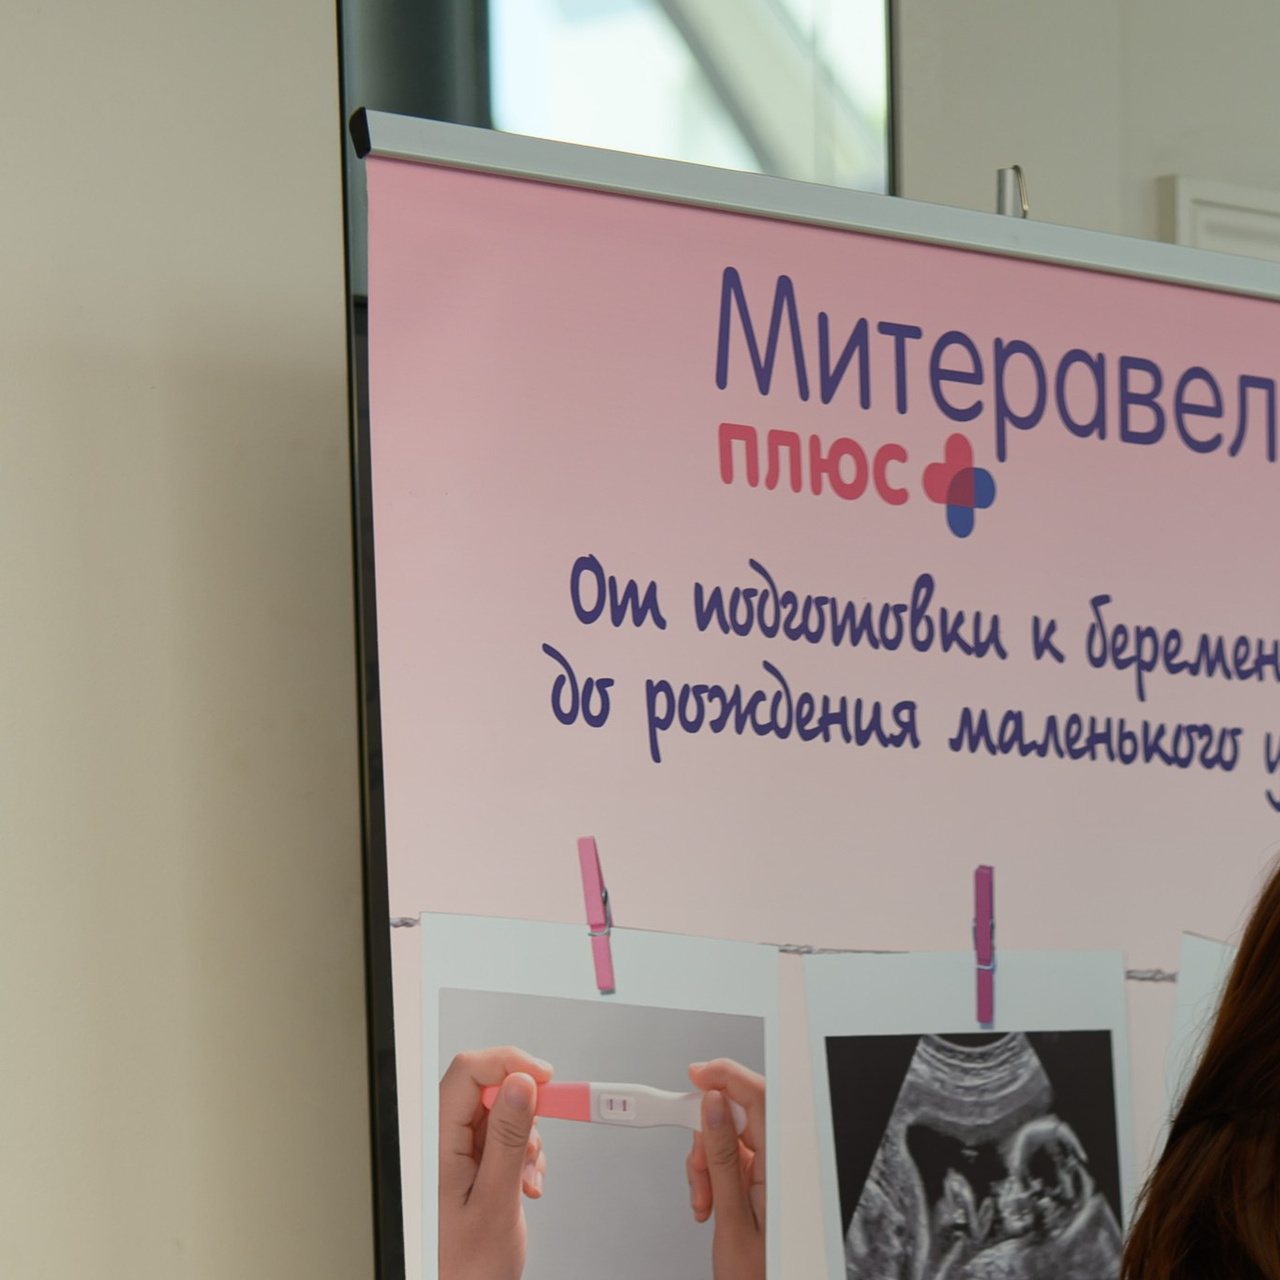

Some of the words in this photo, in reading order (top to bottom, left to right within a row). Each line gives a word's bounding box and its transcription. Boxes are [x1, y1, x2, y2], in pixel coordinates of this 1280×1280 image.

[717, 421, 910, 506] плюс
[569, 553, 666, 631] От
[693, 558, 1008, 661] подготовки
[1031, 609, 1065, 664] к
[542, 644, 614, 728] до
[645, 661, 921, 763] рождения
[948, 706, 1242, 772] маленького
